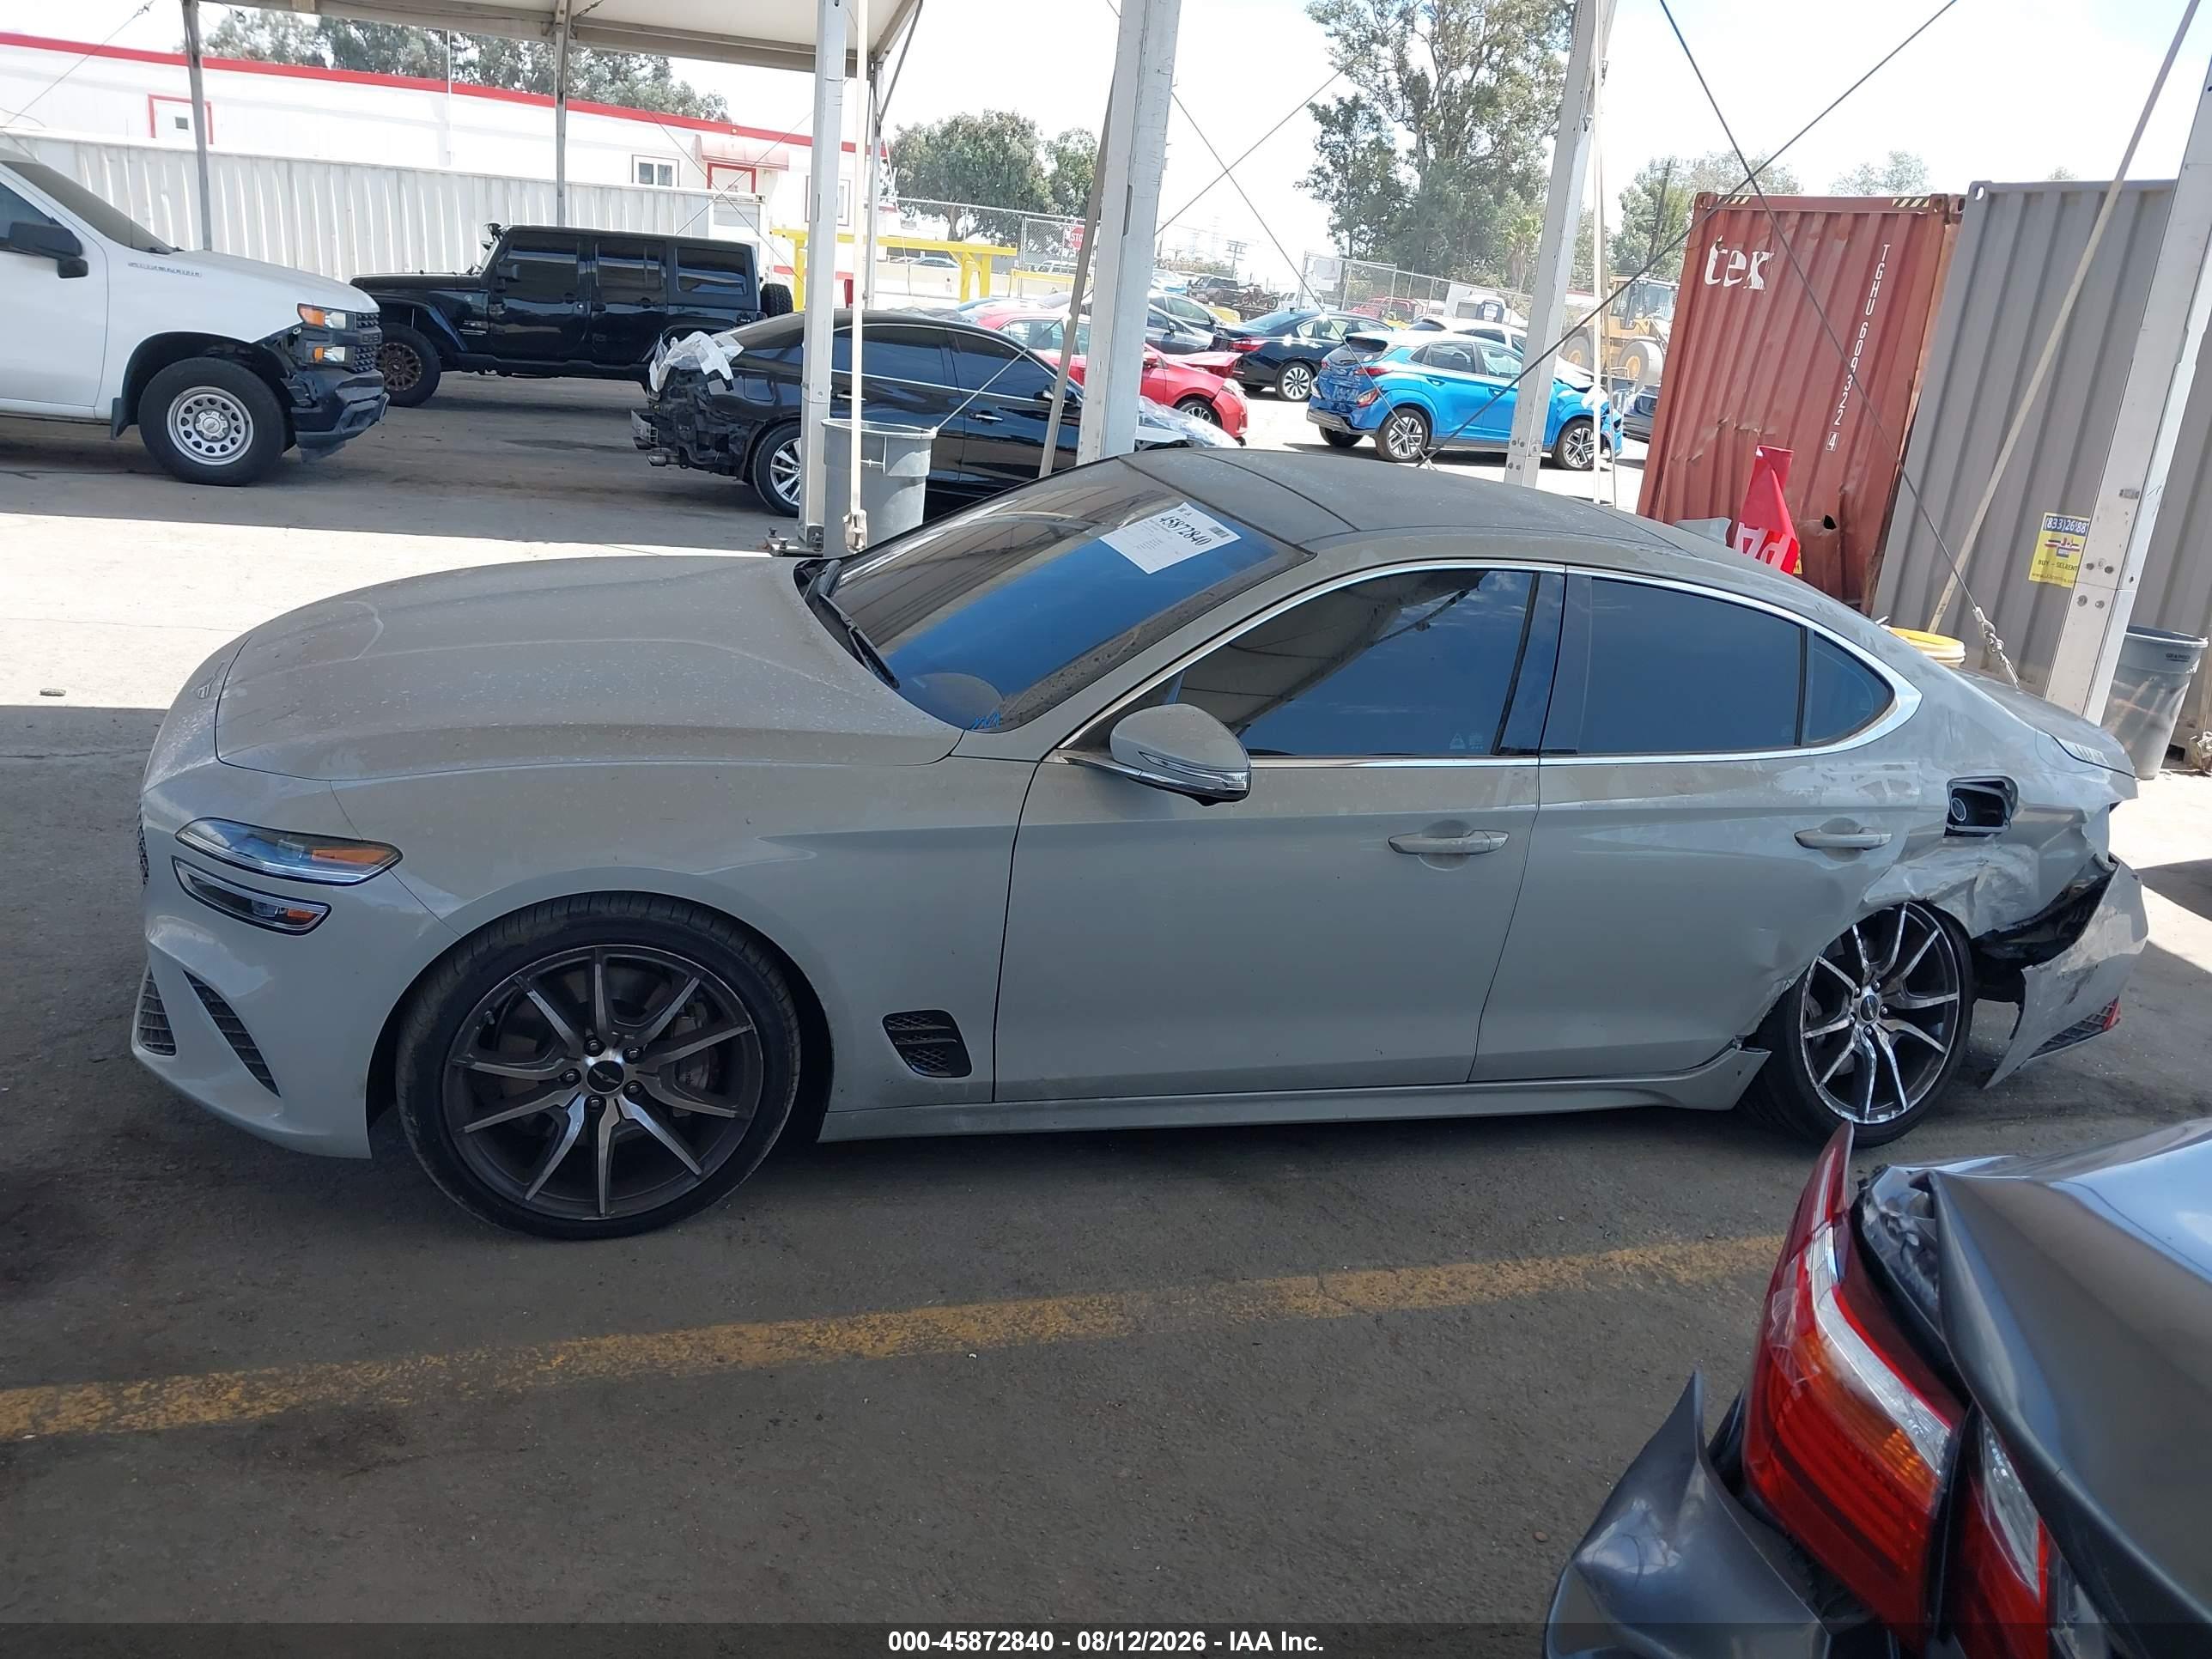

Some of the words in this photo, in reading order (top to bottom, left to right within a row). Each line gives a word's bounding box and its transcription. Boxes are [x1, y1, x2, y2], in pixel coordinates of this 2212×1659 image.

[1865, 244, 1891, 316] TGHU
[1833, 321, 1869, 426] 609322
[1827, 432, 1838, 451] 4
[1159, 516, 1212, 545] 45872840
